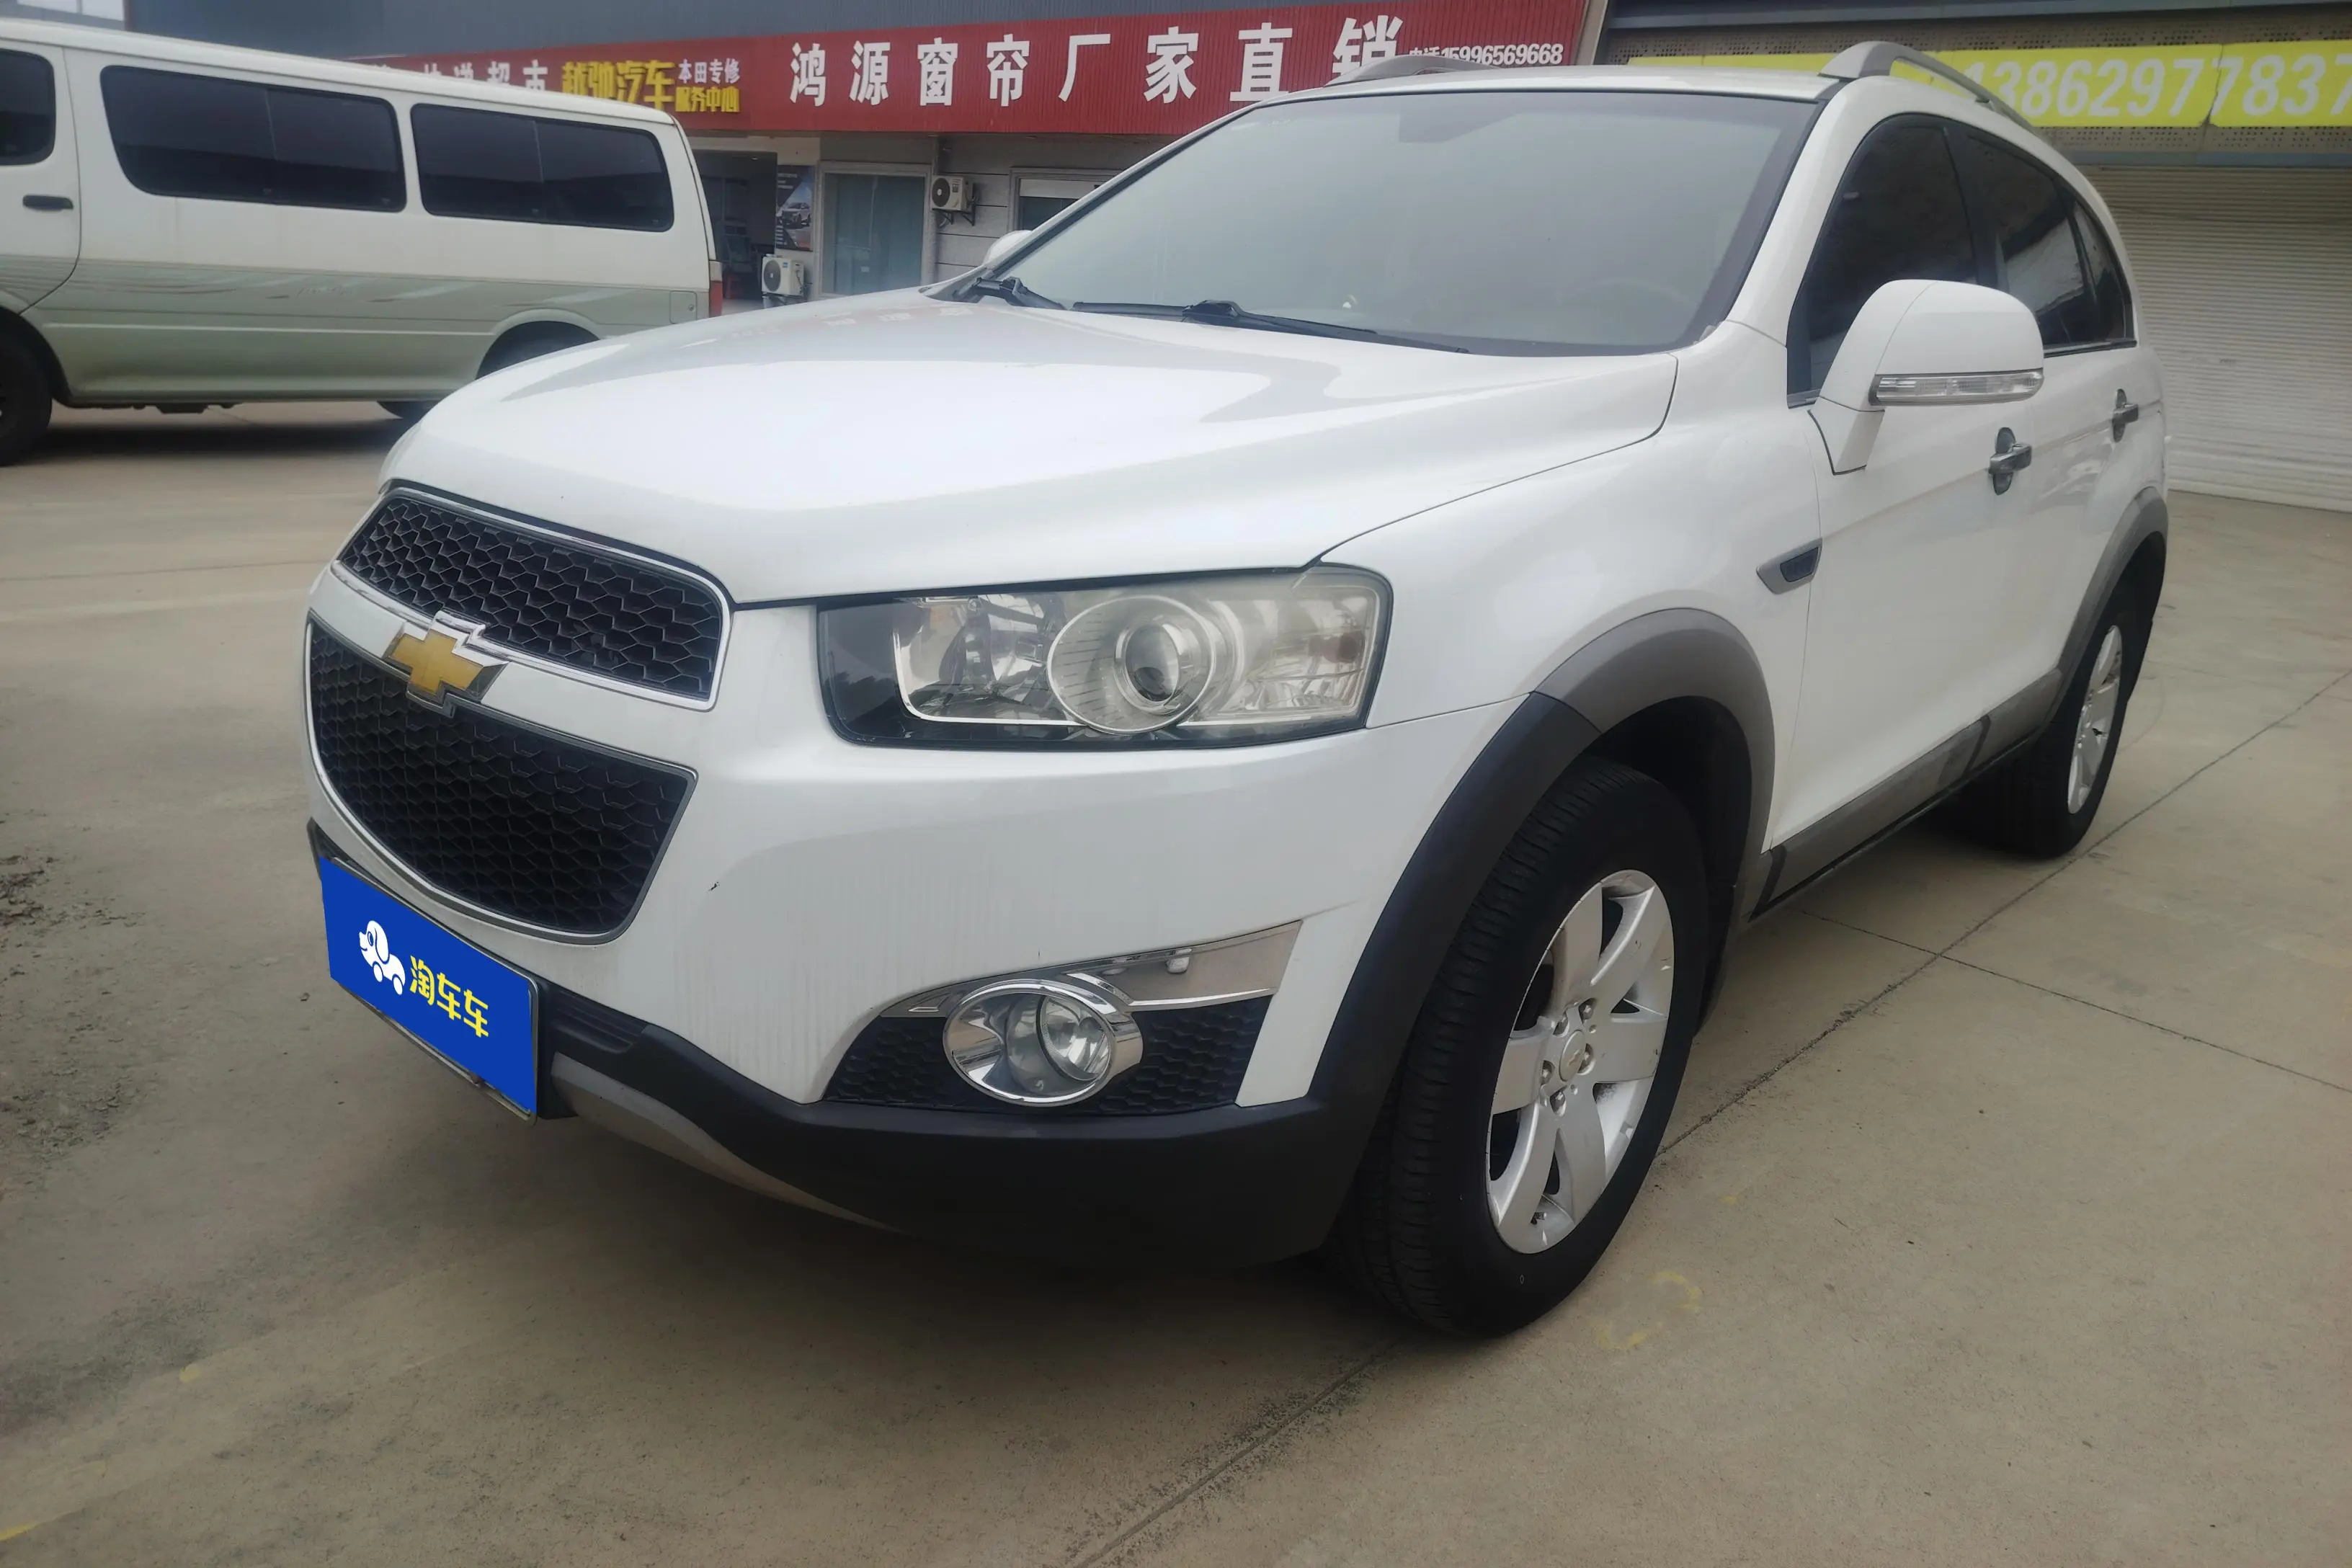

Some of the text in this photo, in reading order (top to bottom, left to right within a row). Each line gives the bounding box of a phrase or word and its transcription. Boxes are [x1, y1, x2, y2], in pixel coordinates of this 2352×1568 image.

[678, 58, 740, 84] 本田专修
[675, 86, 739, 112] 服务中心
